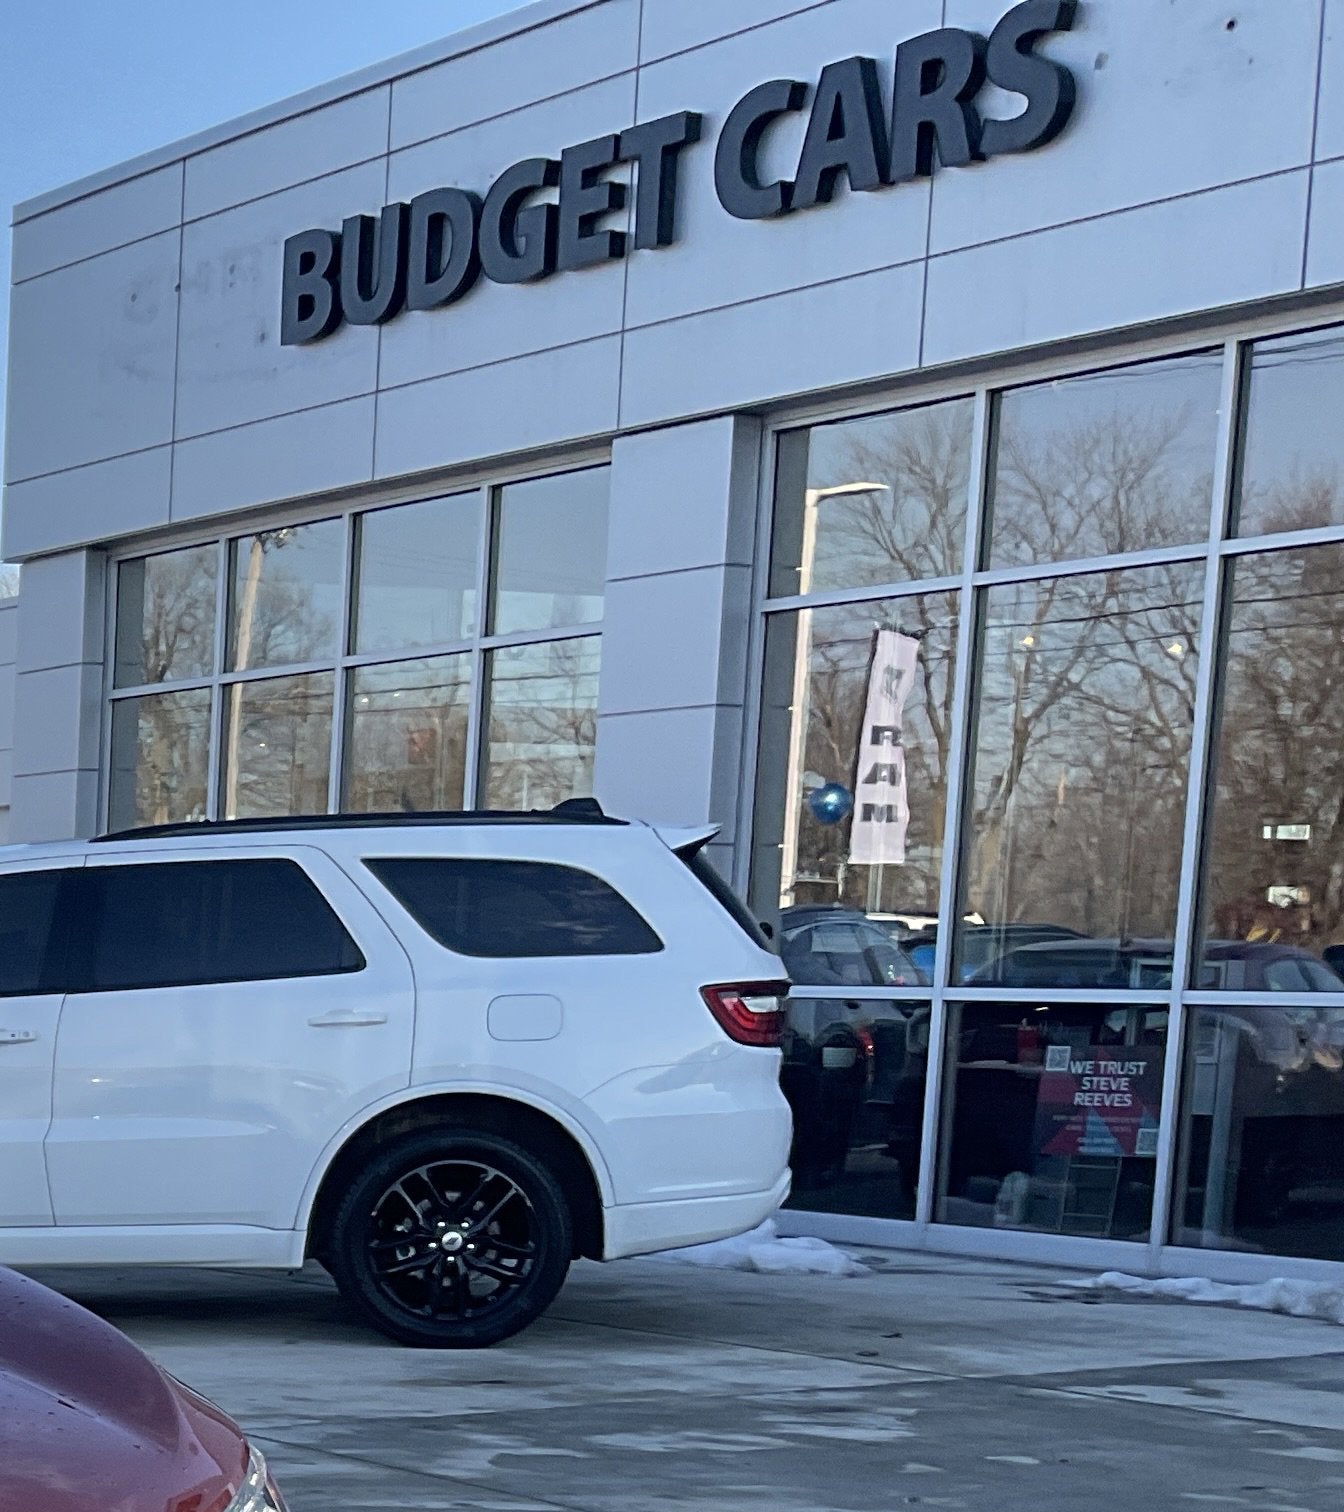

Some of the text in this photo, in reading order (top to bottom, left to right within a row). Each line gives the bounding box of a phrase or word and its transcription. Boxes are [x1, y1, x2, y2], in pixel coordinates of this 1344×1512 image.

[280, 0, 1077, 347] BUDGET CARS
[859, 724, 902, 824] RAM
[1070, 1060, 1147, 1075] WE TRUST
[1081, 1076, 1130, 1090] STEVE
[1073, 1092, 1132, 1106] REEVES
